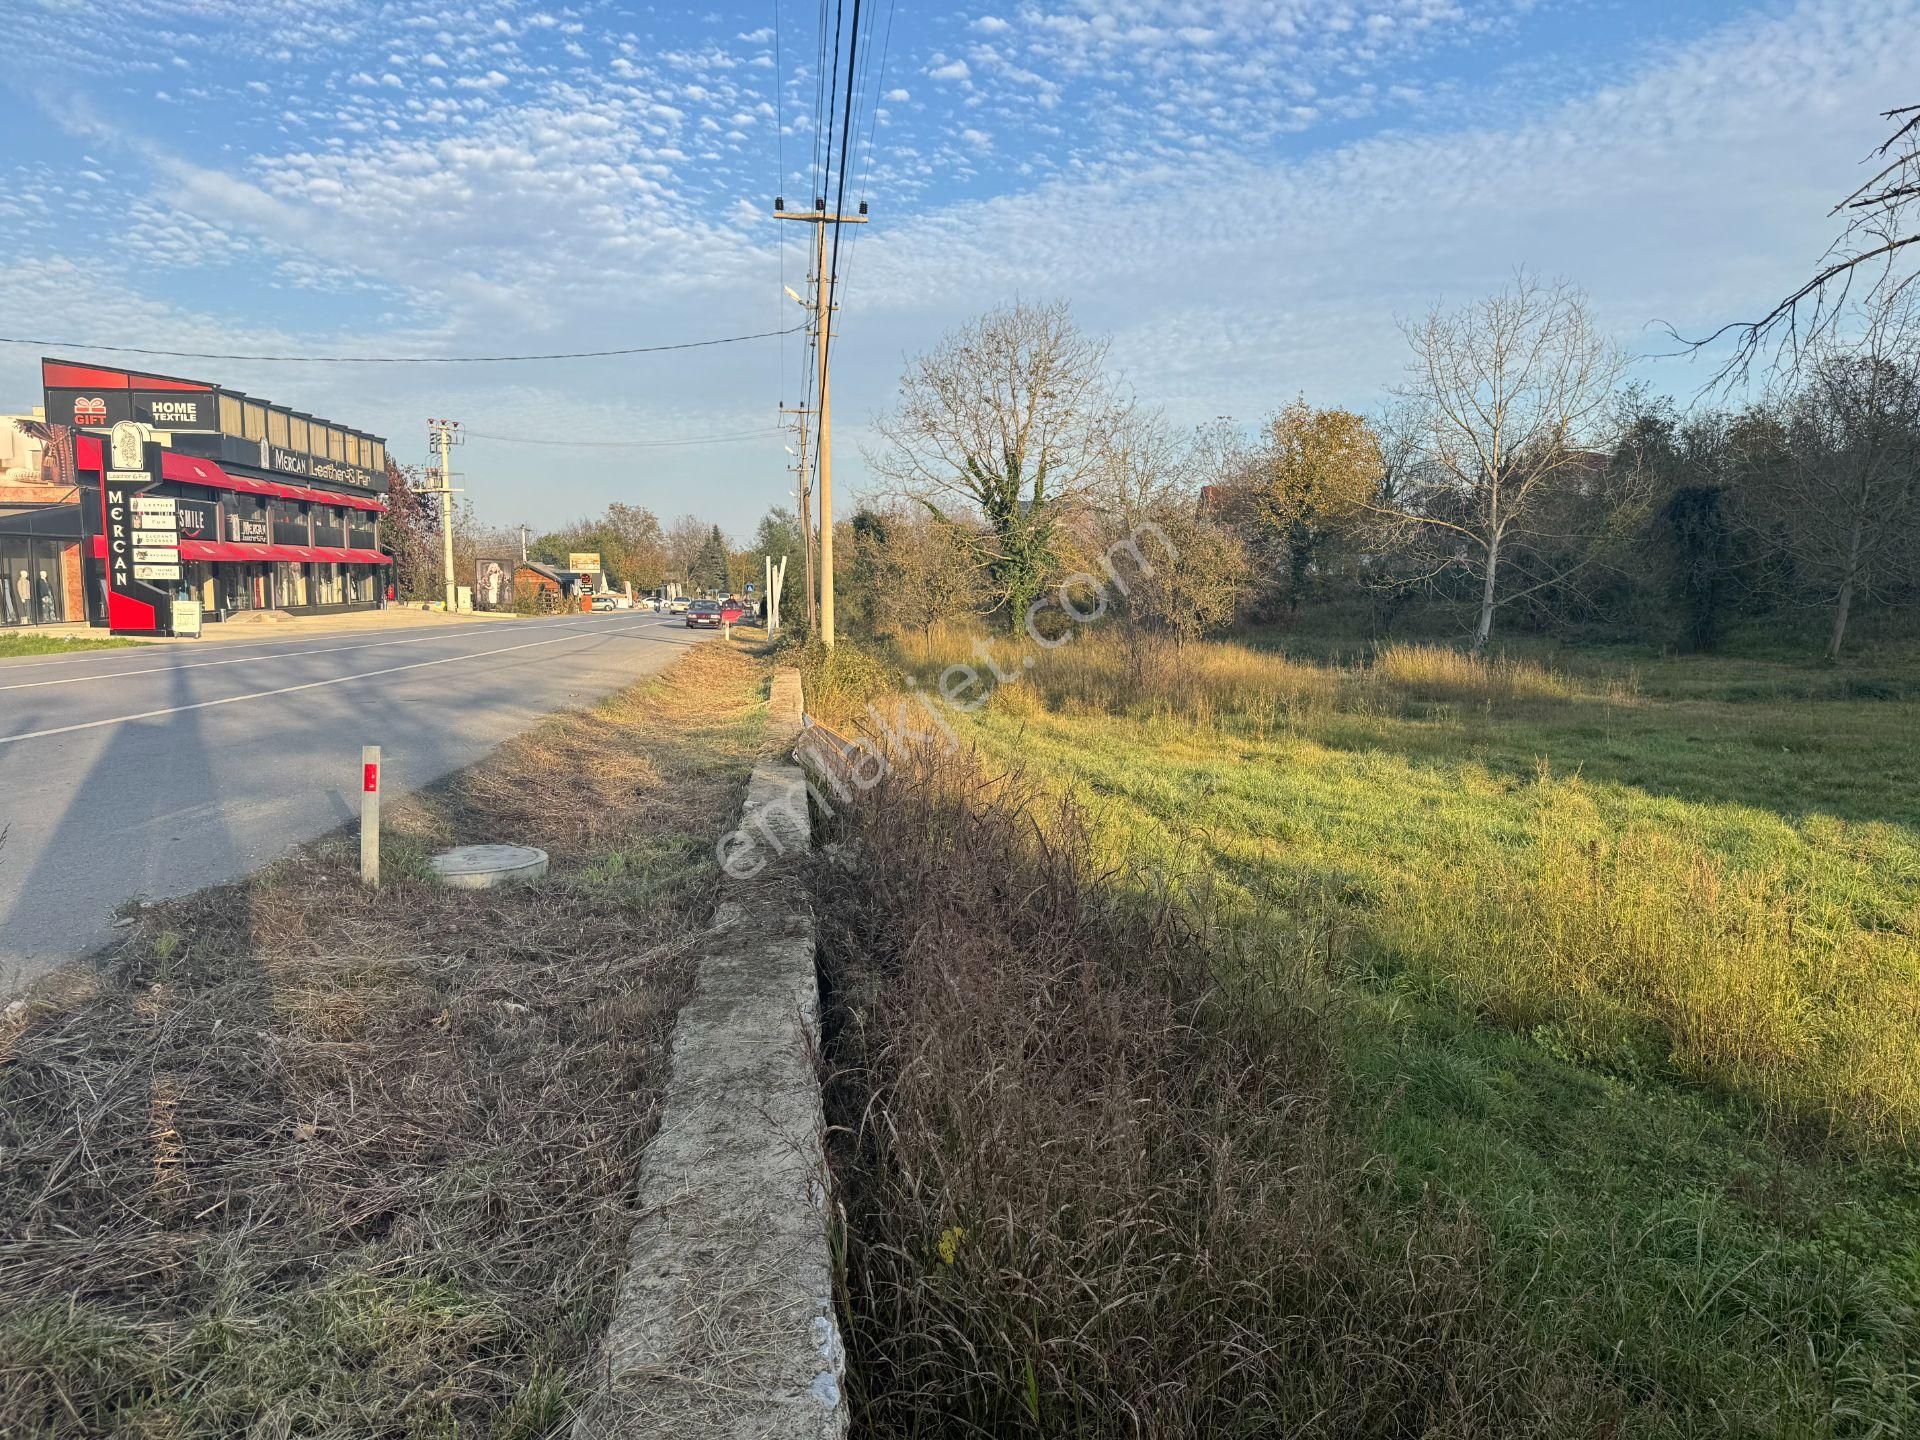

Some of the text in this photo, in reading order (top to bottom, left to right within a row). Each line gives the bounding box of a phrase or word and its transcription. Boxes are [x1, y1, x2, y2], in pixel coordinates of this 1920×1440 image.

[152, 401, 197, 413] HOME
[74, 414, 107, 425] GIFT
[153, 412, 197, 422] TEXTILE
[275, 449, 306, 474] MERCAN
[309, 457, 347, 482] Leather
[356, 470, 371, 487] Fur
[179, 509, 205, 529] SMILE
[108, 490, 127, 586] MERCAN
